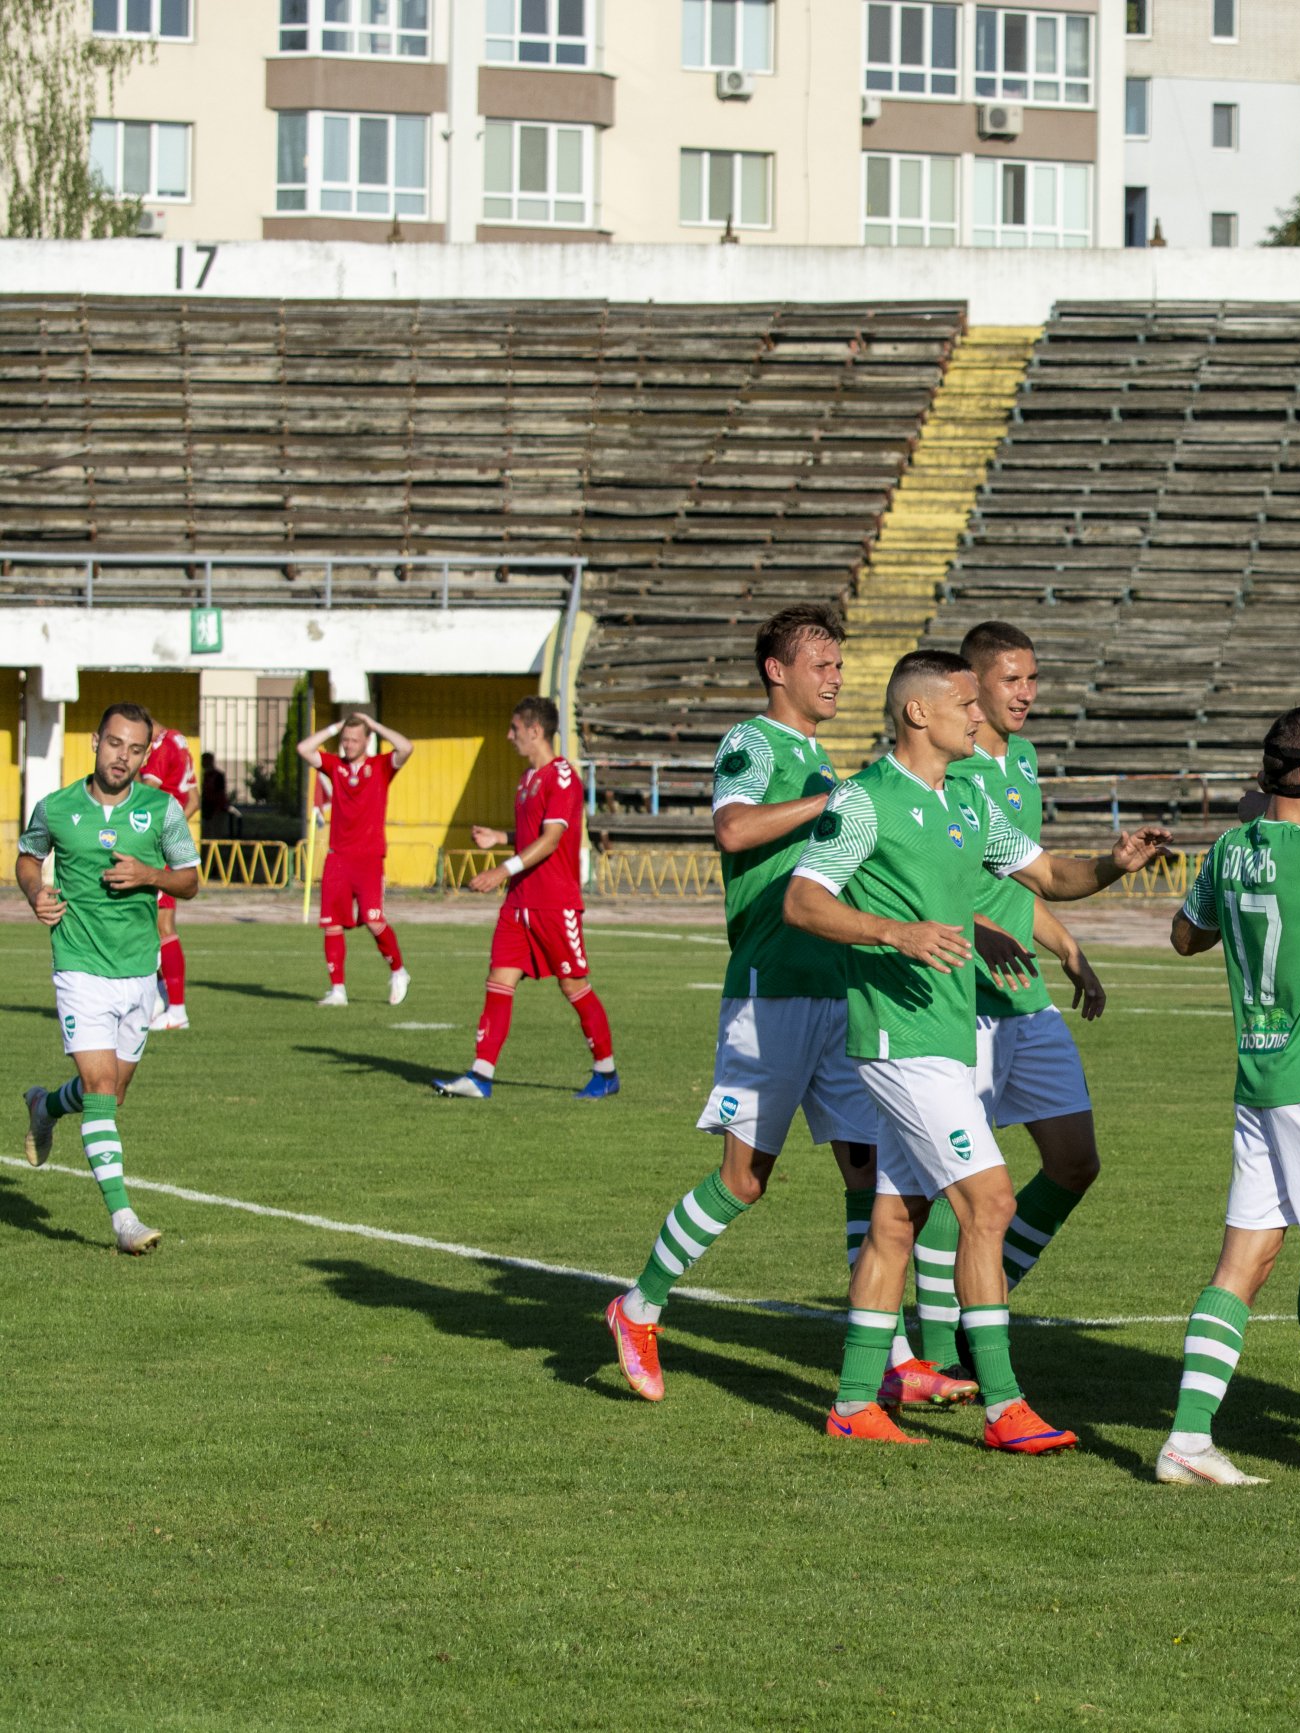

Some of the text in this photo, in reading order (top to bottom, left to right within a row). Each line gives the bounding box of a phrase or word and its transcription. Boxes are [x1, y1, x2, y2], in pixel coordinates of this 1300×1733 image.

[176, 246, 218, 289] 17
[561, 961, 572, 975] 3
[1224, 890, 1283, 1005] 17
